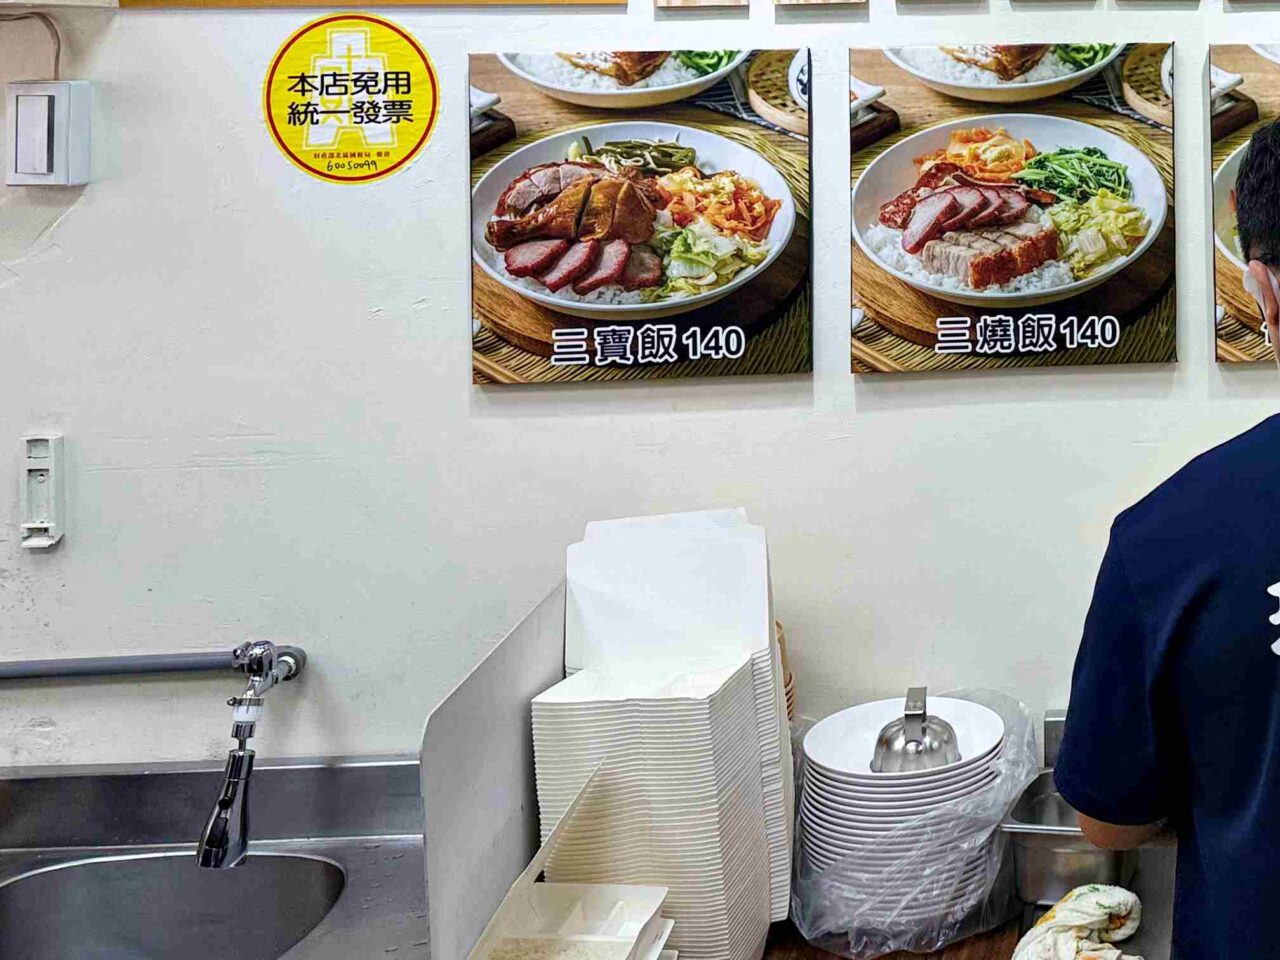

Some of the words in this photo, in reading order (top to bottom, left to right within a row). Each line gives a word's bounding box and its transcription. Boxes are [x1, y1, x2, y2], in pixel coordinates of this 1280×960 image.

[287, 71, 412, 97] 本店免用
[287, 100, 414, 126] 統一發票
